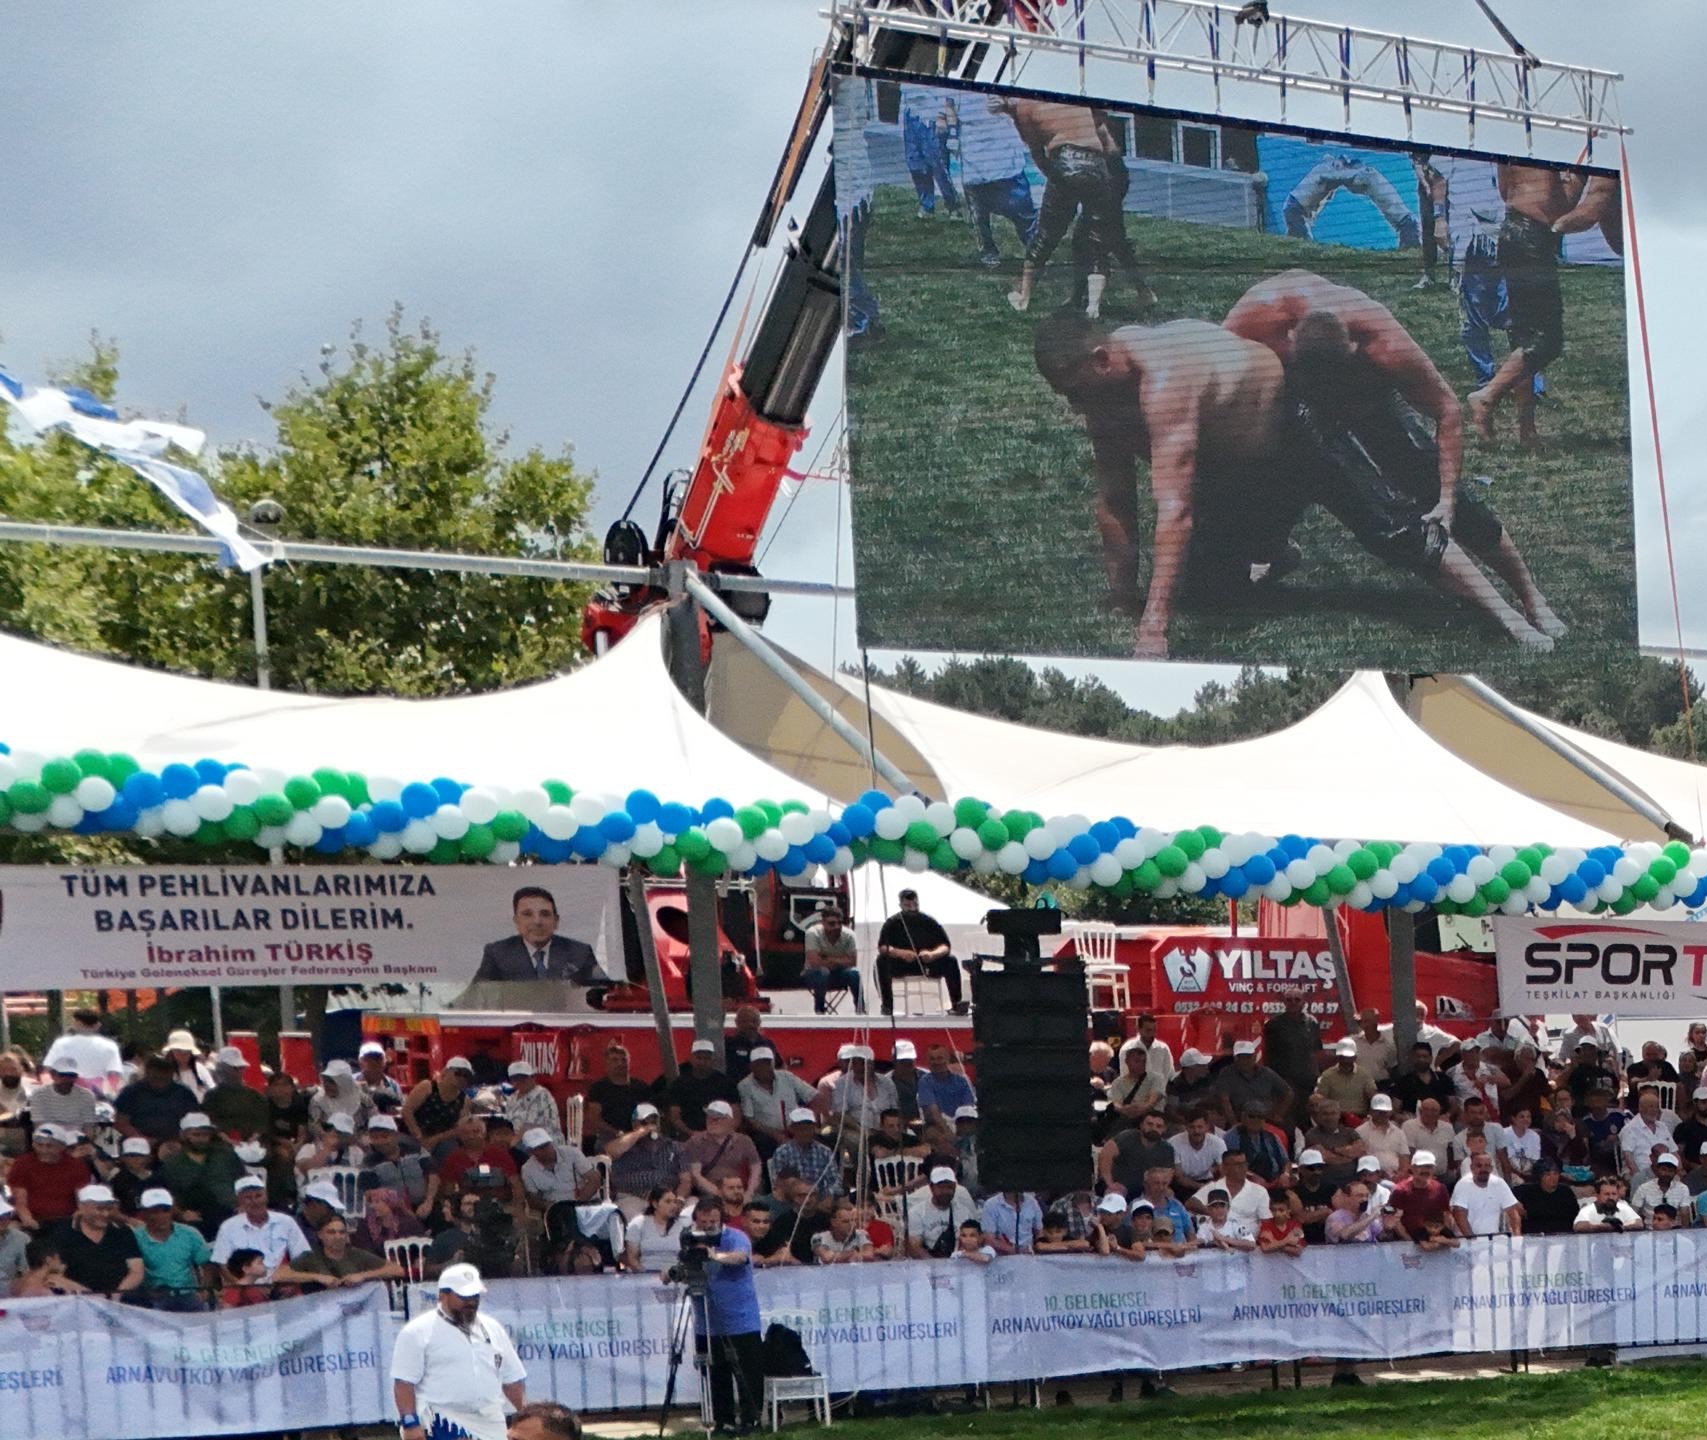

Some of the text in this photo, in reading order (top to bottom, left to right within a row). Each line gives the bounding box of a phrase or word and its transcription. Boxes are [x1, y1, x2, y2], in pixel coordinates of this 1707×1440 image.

[61, 869, 435, 897] TÜM PEHLİVANLARIMIZA
[96, 902, 413, 938] BAŞARILAR DİLERİM.
[147, 941, 373, 965] İbrahim TÜRKİŞ
[1525, 942, 1677, 985] SPOR
[1216, 950, 1336, 989] YILTAŞ
[1257, 983, 1264, 992] &
[1526, 989, 1675, 1001] TEŞKİLAT BAŞKANLIĞI
[1065, 1291, 1150, 1310] GELENEKSEL
[279, 1350, 375, 1377] GÜREŞLERİ
